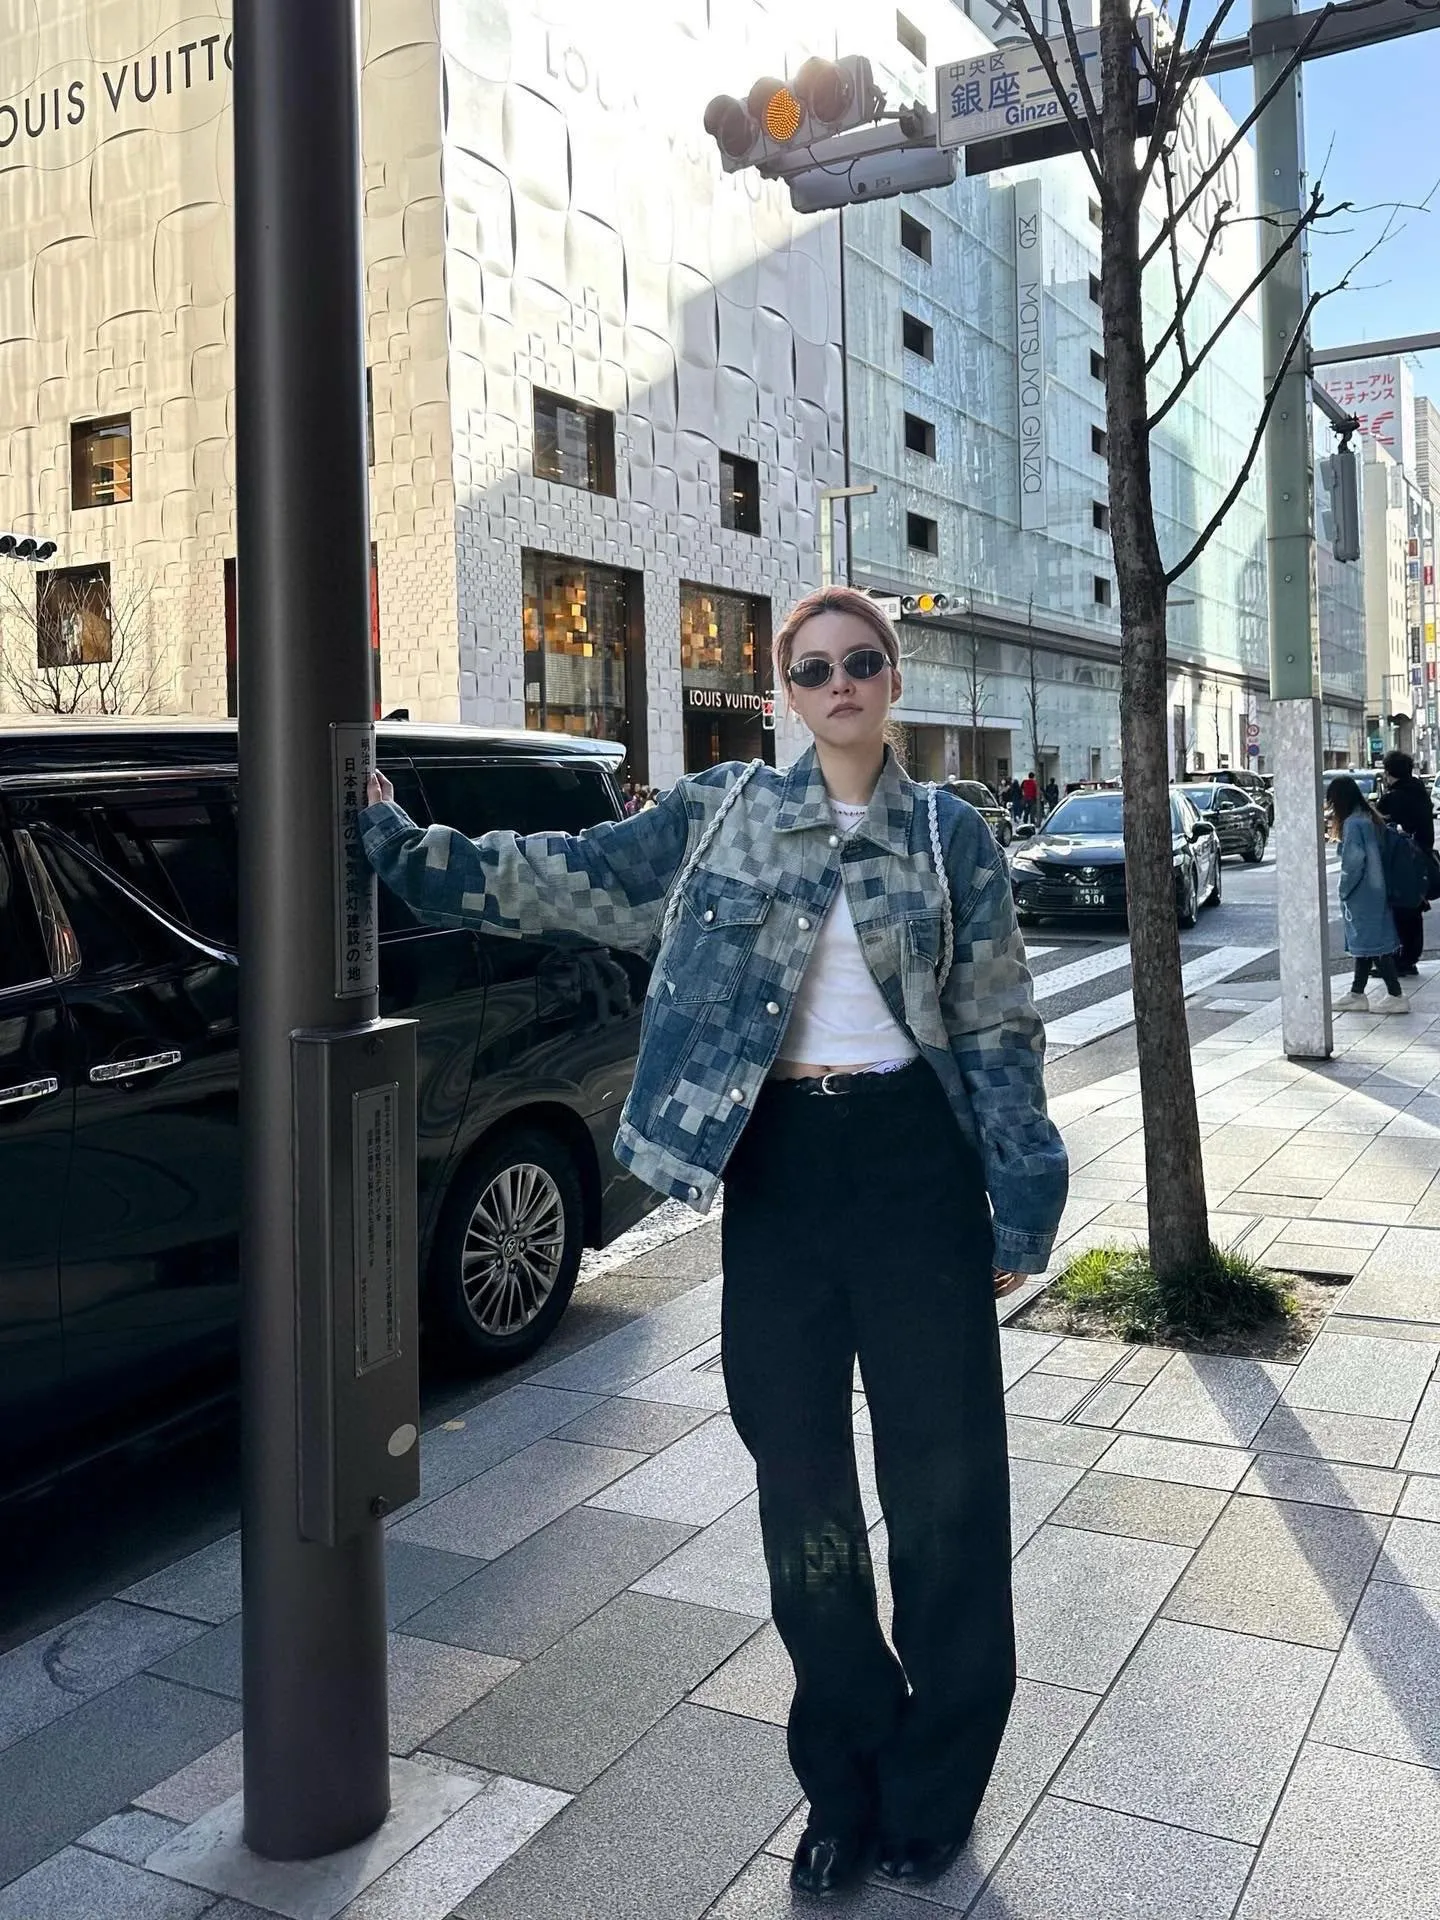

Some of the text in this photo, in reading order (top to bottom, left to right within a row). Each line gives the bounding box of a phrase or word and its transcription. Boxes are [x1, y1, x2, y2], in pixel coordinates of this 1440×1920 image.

[949, 52, 1006, 82] 中央区
[1004, 100, 1058, 126] Ginza
[689, 689, 722, 708] LOUIS
